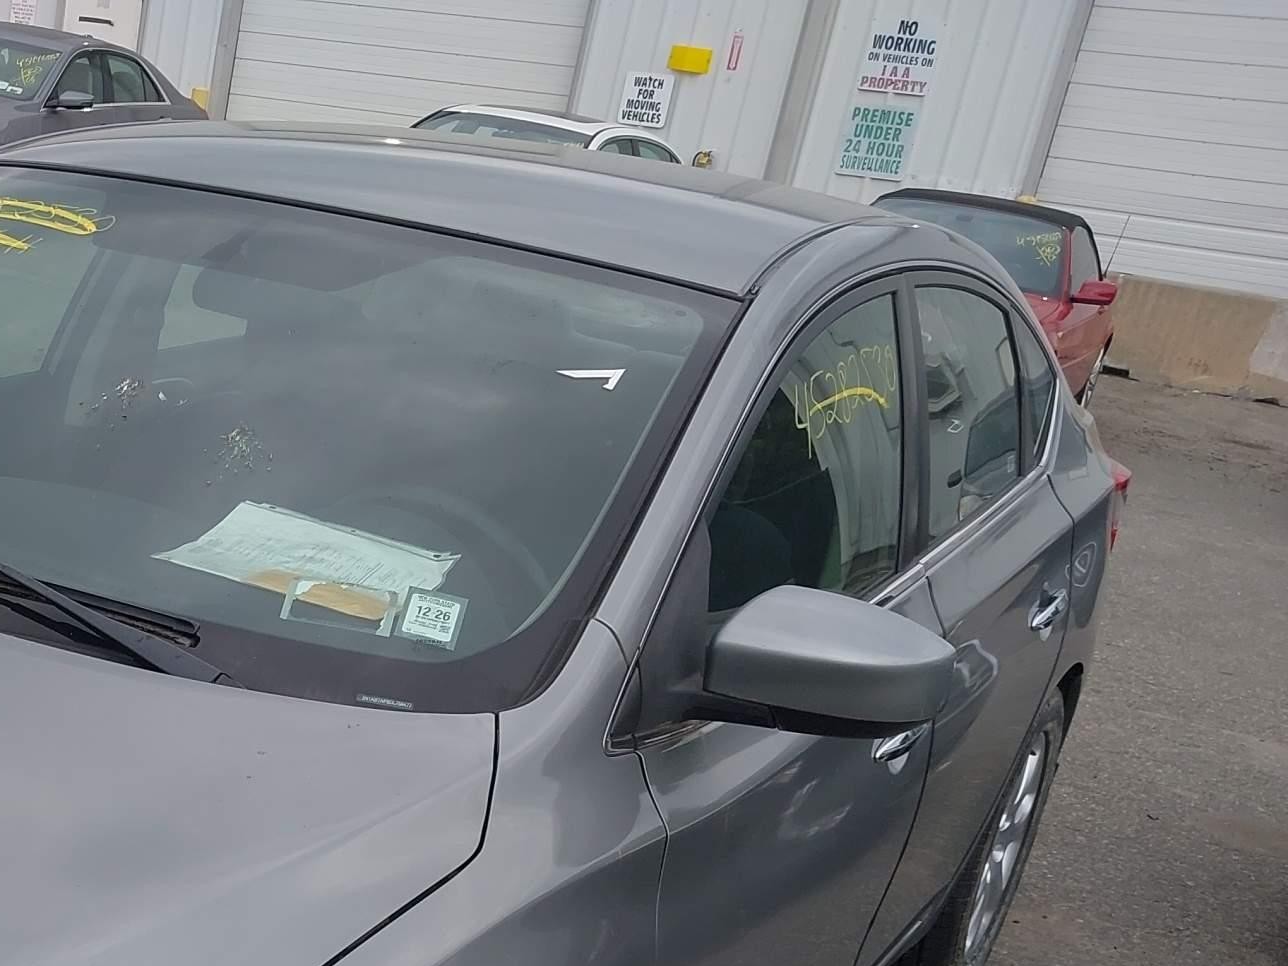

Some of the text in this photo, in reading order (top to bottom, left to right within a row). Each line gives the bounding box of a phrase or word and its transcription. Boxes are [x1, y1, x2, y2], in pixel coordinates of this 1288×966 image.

[897, 20, 919, 36] NO
[872, 34, 936, 55] WORKING
[868, 52, 934, 67] ON VEHICLES ON
[634, 76, 664, 89] WATCH
[860, 76, 927, 93] PROPERTY
[637, 89, 655, 99] FOR
[625, 99, 661, 112] MOVING
[621, 110, 661, 124] VEHICLES
[852, 107, 914, 127] PREMISE
[853, 123, 902, 142] UNDER
[843, 138, 904, 159] 24 HOUR
[840, 154, 902, 175] SURVEILLANCE
[434, 609, 451, 622] 26
